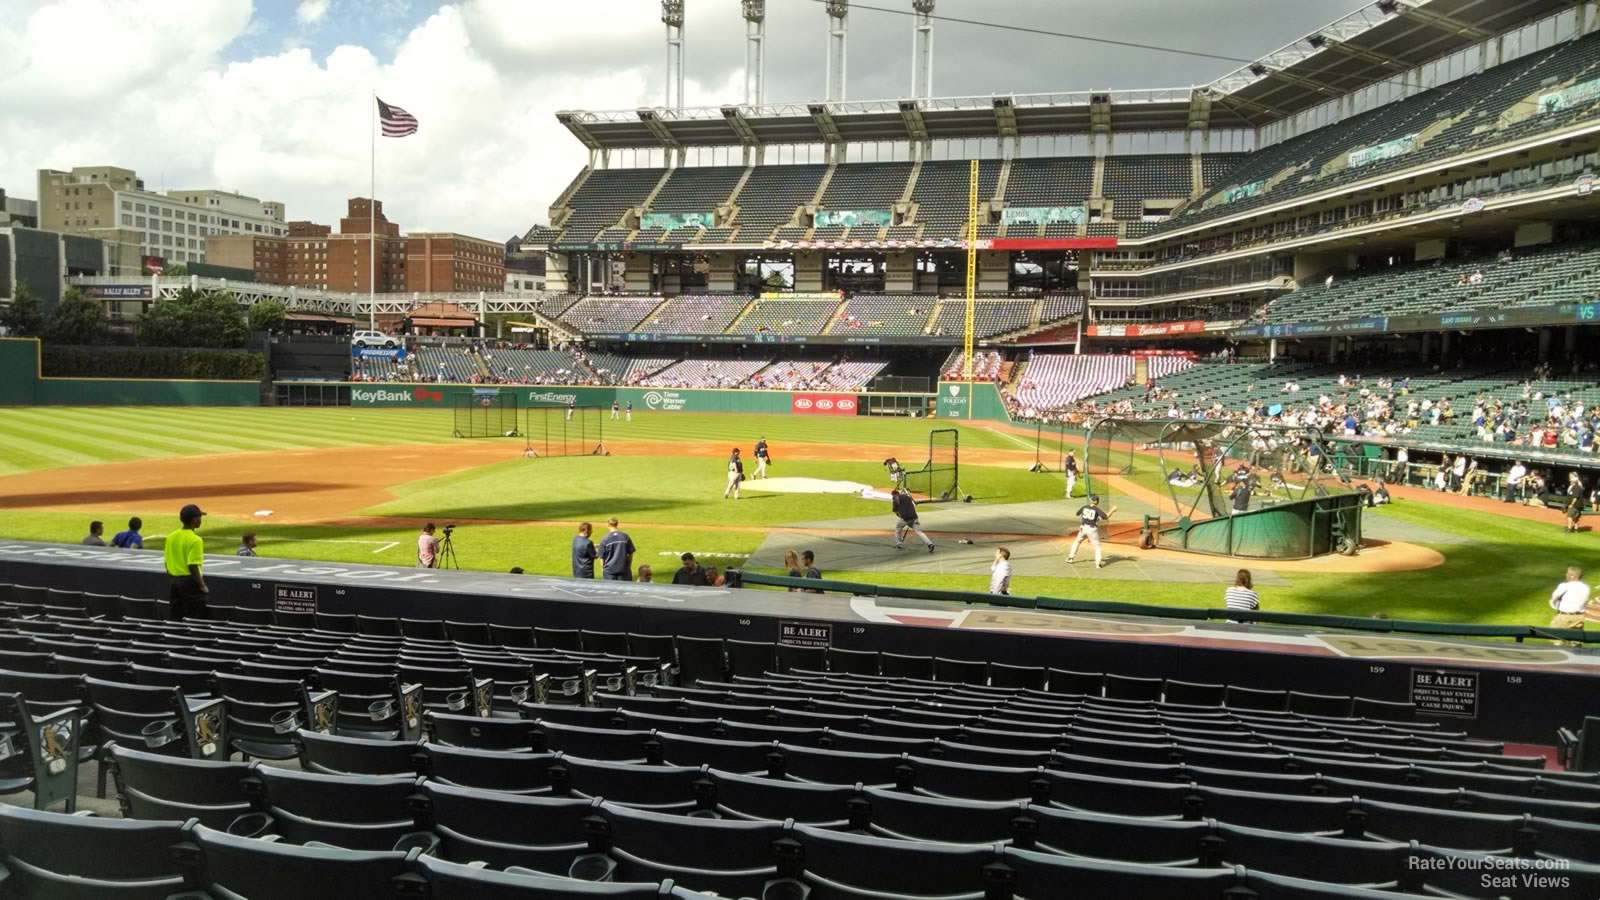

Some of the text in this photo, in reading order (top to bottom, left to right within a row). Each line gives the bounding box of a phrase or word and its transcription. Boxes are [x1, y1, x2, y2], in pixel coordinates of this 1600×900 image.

[1006, 210, 1030, 218] LEMON
[1580, 306, 1595, 319] VS
[352, 390, 412, 402] KeyBank
[529, 392, 576, 402] FirstEnergy
[278, 589, 314, 599] BE ALERT
[783, 627, 828, 637] BE ALERT
[1369, 666, 1385, 674] 159
[1416, 674, 1474, 687] BE ALERT
[1506, 676, 1522, 684] 158
[1413, 688, 1439, 696] OBJECTS
